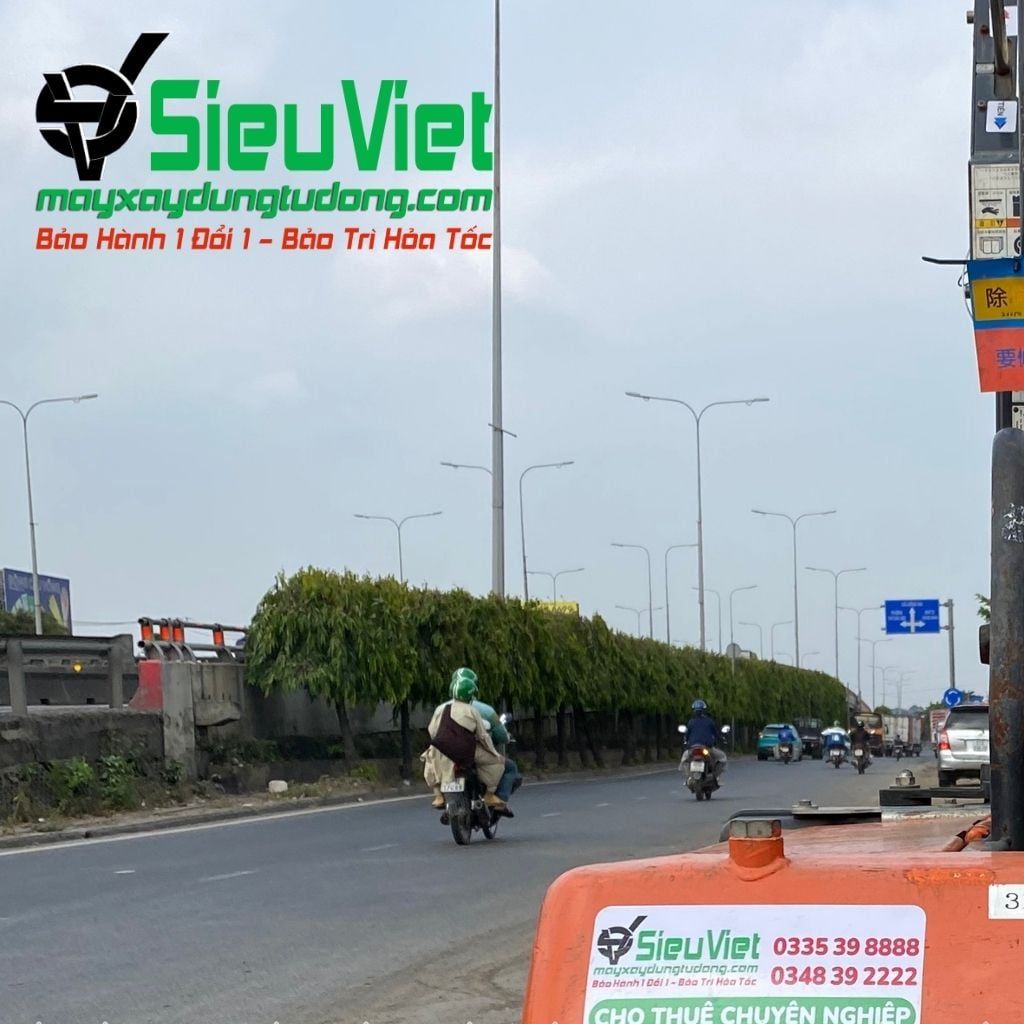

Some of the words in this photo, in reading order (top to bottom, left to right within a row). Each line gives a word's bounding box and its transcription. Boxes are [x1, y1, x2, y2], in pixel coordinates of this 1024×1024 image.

[635, 929, 760, 961] SieuViet
[773, 937, 827, 956] 0335
[832, 937, 860, 956] 39
[864, 937, 919, 956] 8888
[593, 963, 758, 977] mayxaydungtudong.com
[770, 966, 826, 986] 0348
[831, 966, 858, 985] 39
[863, 966, 917, 985] 2222
